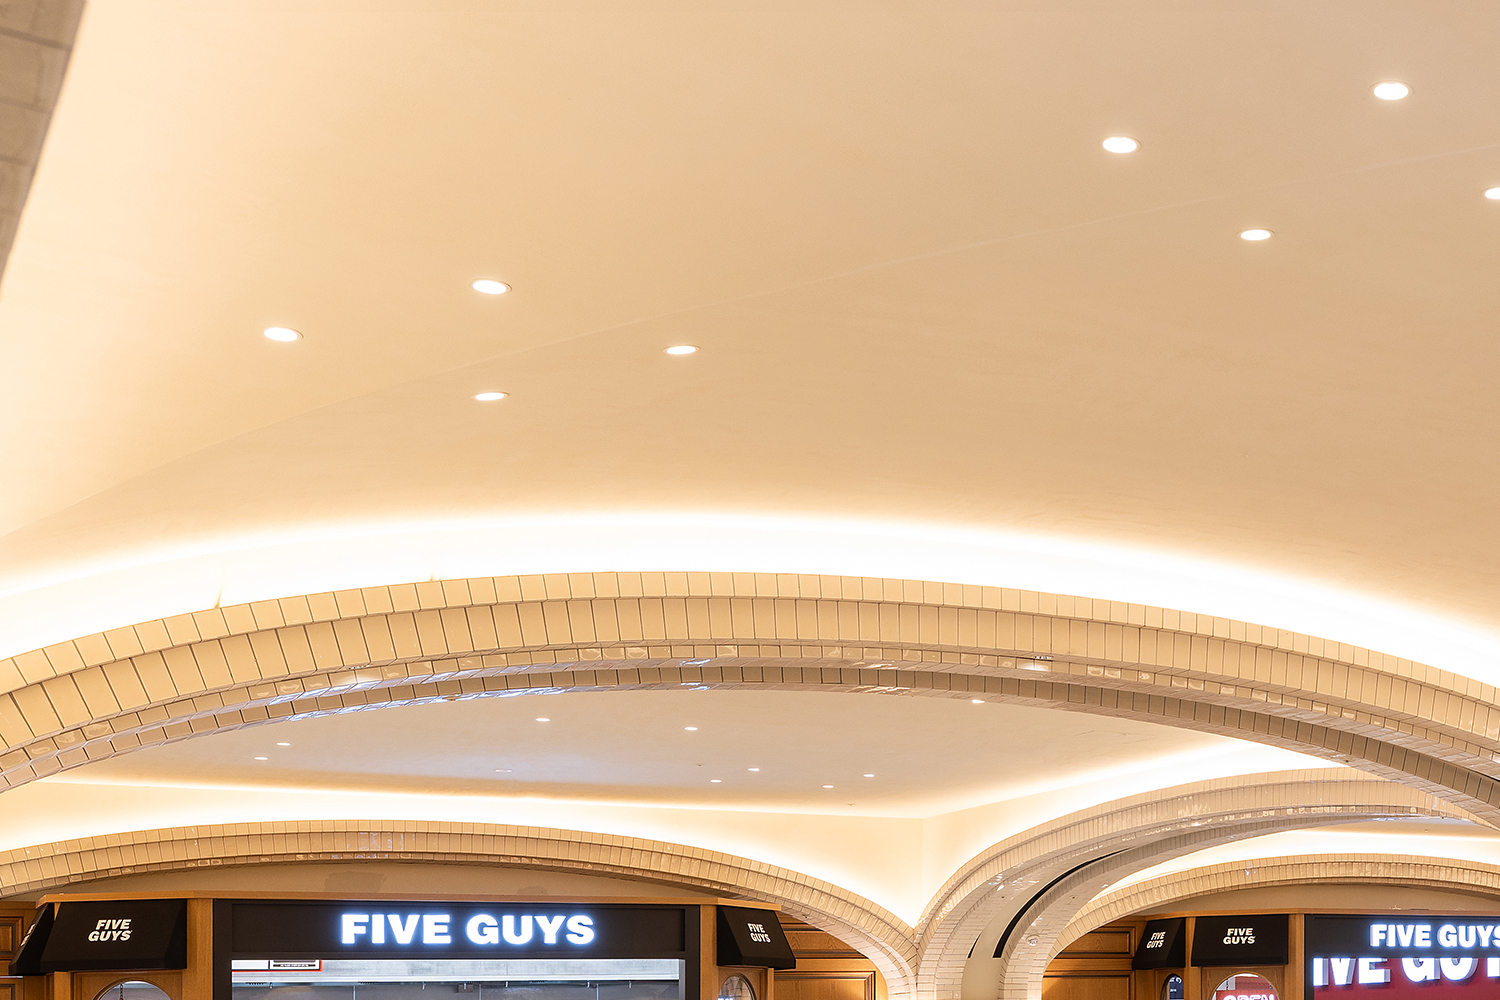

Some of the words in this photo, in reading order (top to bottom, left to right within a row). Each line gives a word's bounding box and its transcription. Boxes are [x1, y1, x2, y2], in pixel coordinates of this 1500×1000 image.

[96, 918, 132, 930] FIVE
[342, 914, 451, 944] FIVE
[466, 914, 594, 944] GUYS
[747, 923, 765, 933] FIVE
[88, 930, 131, 941] GUYS
[1151, 931, 1166, 940] FIVE
[1227, 928, 1253, 936] FIVE
[1371, 924, 1431, 947] FIVE
[750, 932, 771, 943] GUYS
[1223, 936, 1256, 944] GUYS
[1146, 940, 1164, 949] GUYS
